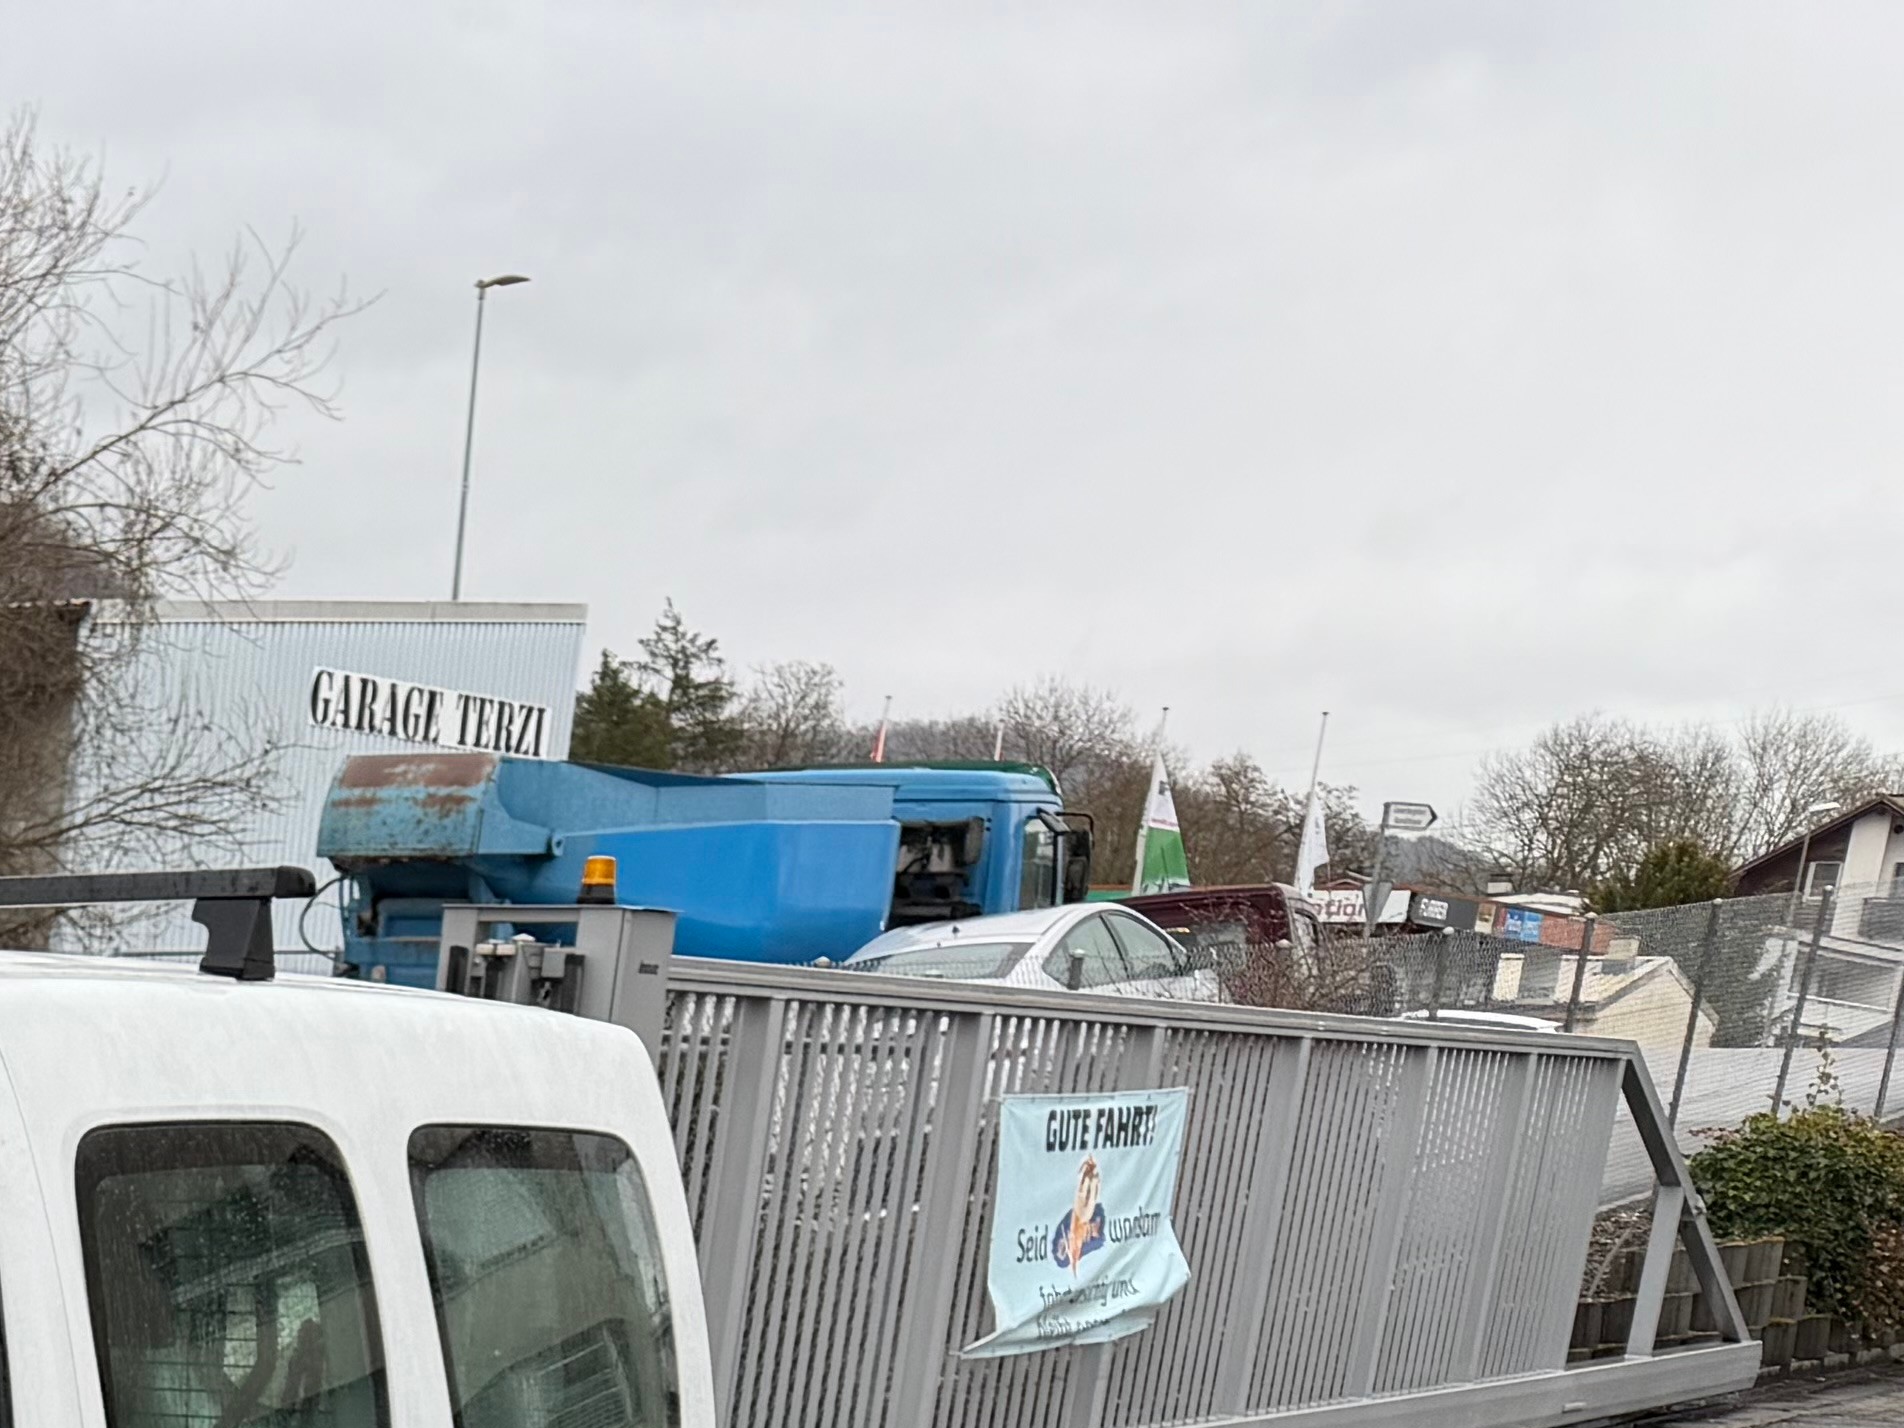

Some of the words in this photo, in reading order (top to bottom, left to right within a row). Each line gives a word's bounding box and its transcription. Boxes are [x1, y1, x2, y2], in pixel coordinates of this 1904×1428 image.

[310, 669, 443, 744] GARAGE
[456, 693, 546, 757] TERZI
[1046, 1109, 1091, 1152] GUTE
[1094, 1104, 1157, 1149] FAHRT!
[1017, 1223, 1049, 1263] Seid
